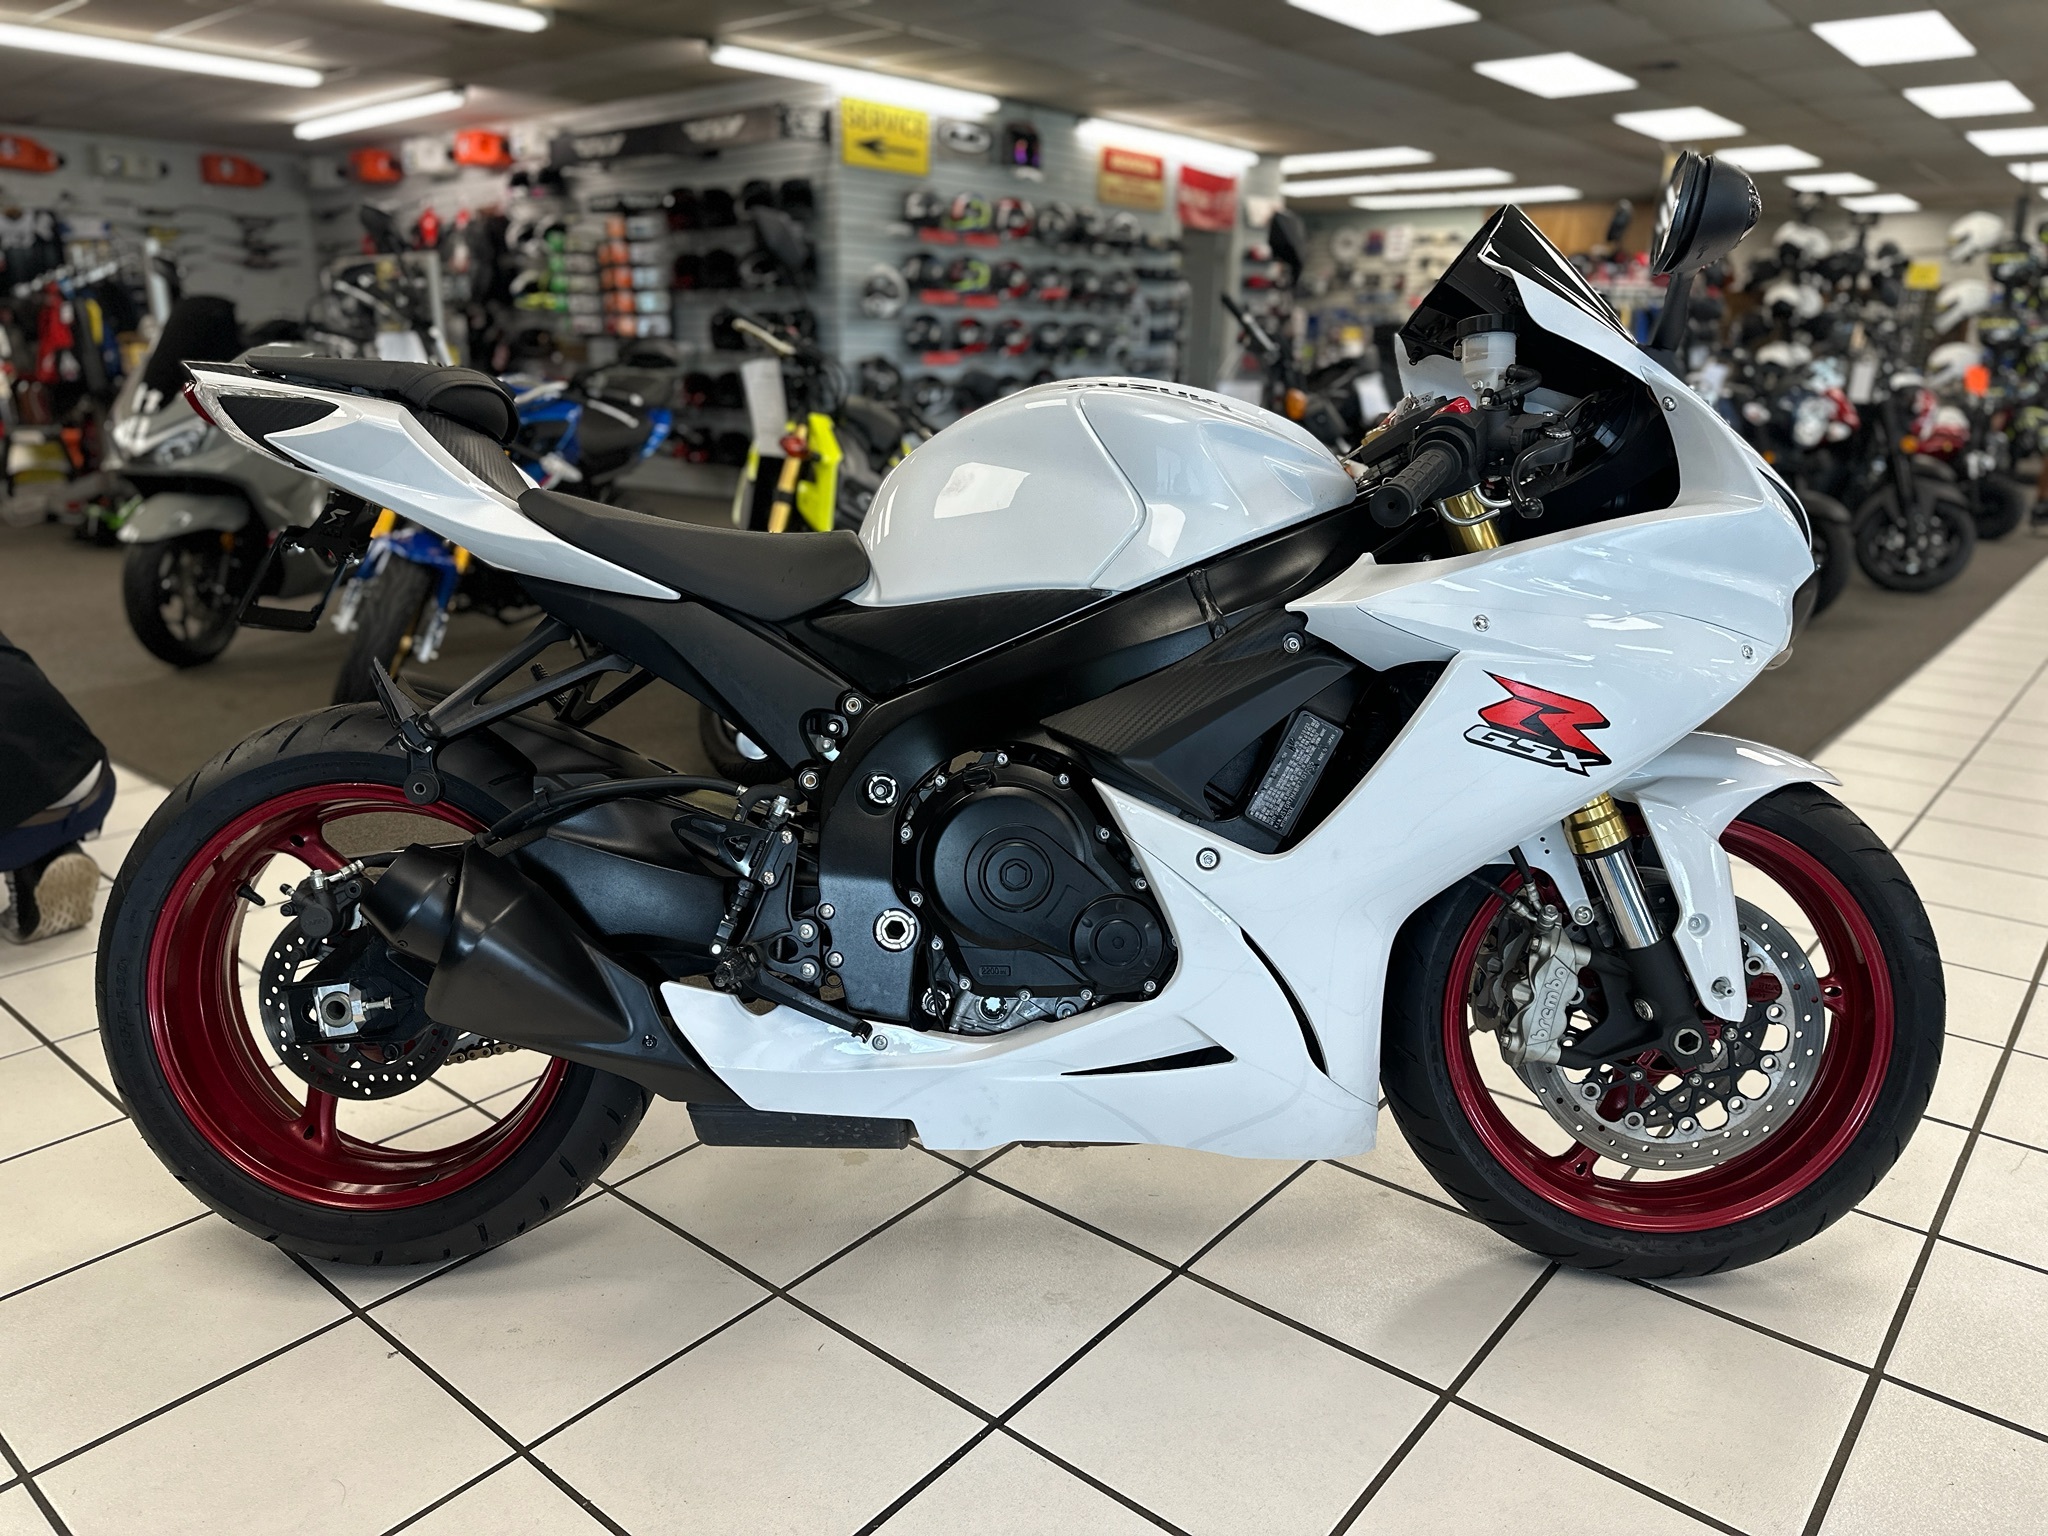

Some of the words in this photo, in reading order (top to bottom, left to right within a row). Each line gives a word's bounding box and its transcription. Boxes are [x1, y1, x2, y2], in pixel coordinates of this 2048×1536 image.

[1478, 669, 1611, 766] R
[1464, 724, 1602, 777] GSX
[981, 966, 999, 975] 2200
[1530, 966, 1568, 1040] brembo
